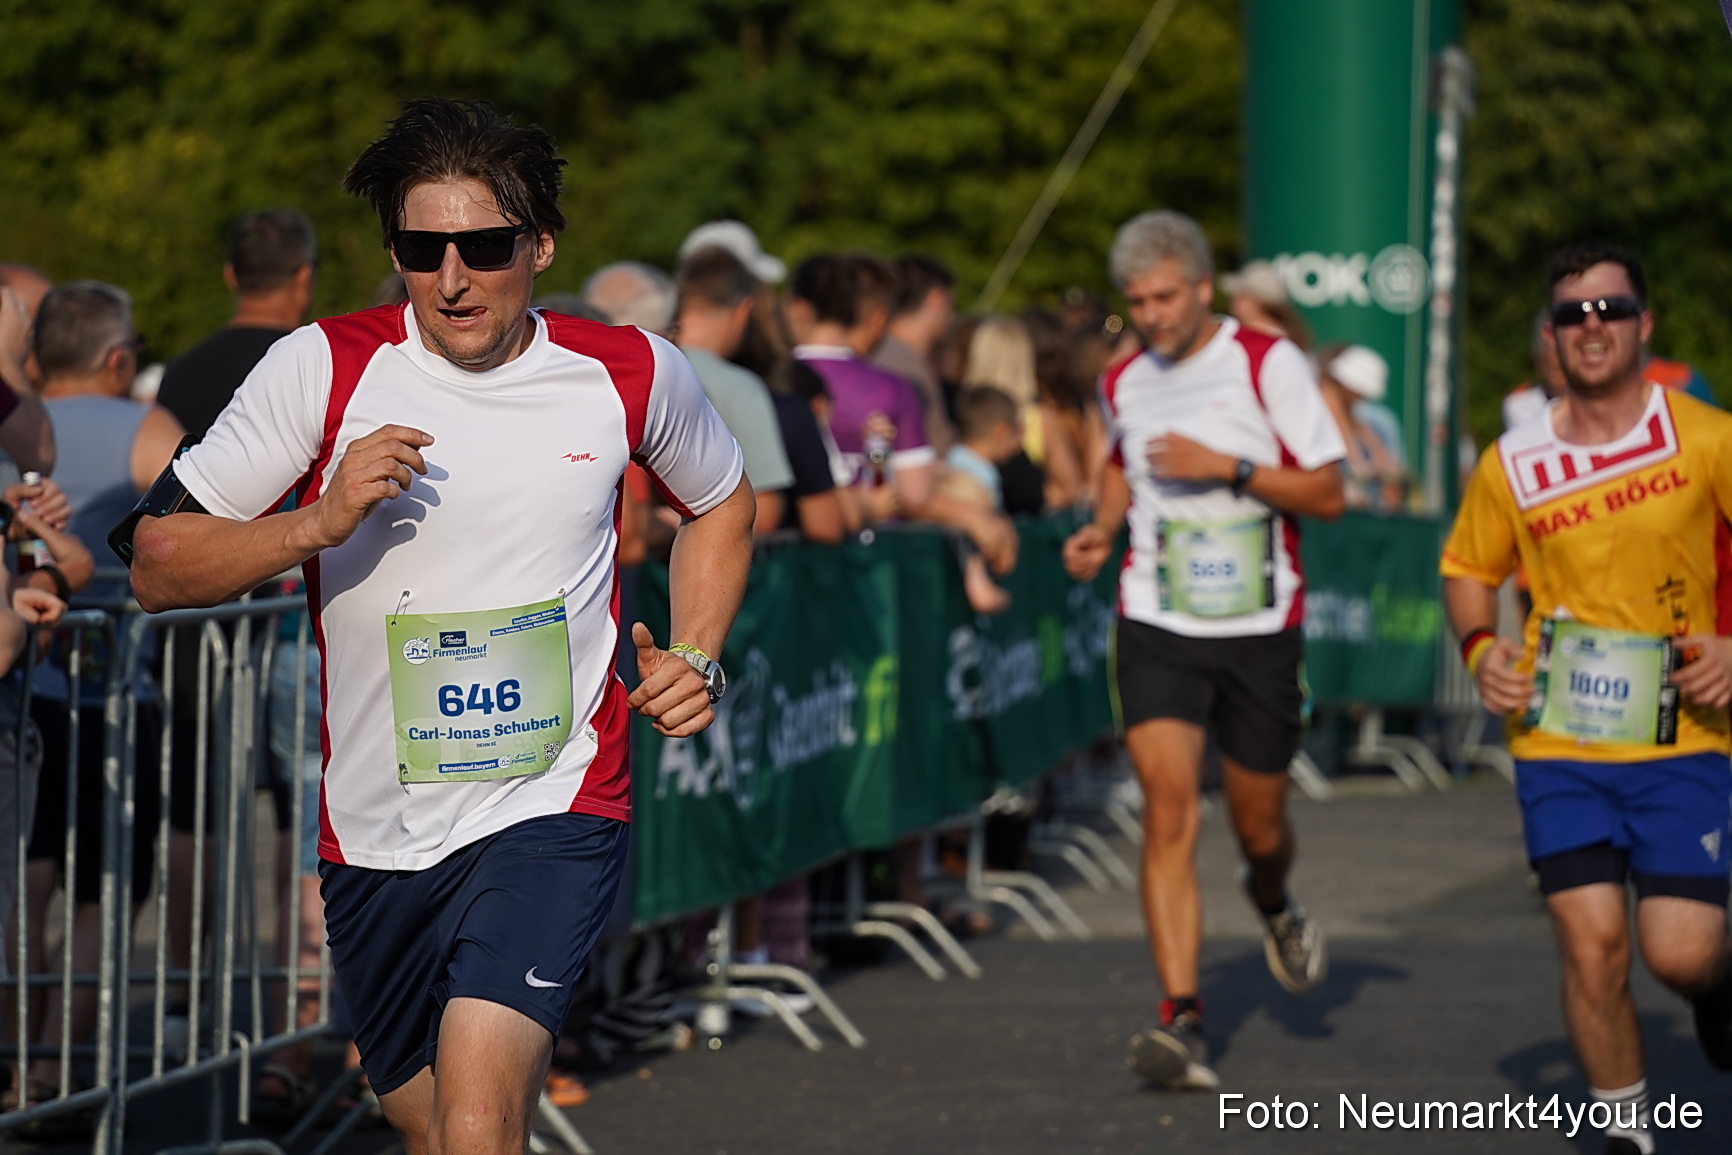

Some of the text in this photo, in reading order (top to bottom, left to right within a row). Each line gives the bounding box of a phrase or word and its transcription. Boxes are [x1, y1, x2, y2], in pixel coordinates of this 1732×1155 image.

[571, 452, 590, 462] DEHN
[1529, 468, 1688, 540] MAX BÖGL
[433, 643, 488, 657] Firmenlauf
[455, 652, 487, 661] neumarkt
[1569, 670, 1629, 702] 1809
[438, 679, 521, 717] 646
[408, 715, 560, 740] Carl-Jonas Schubert
[441, 761, 496, 772] firmenlauf.bayern
